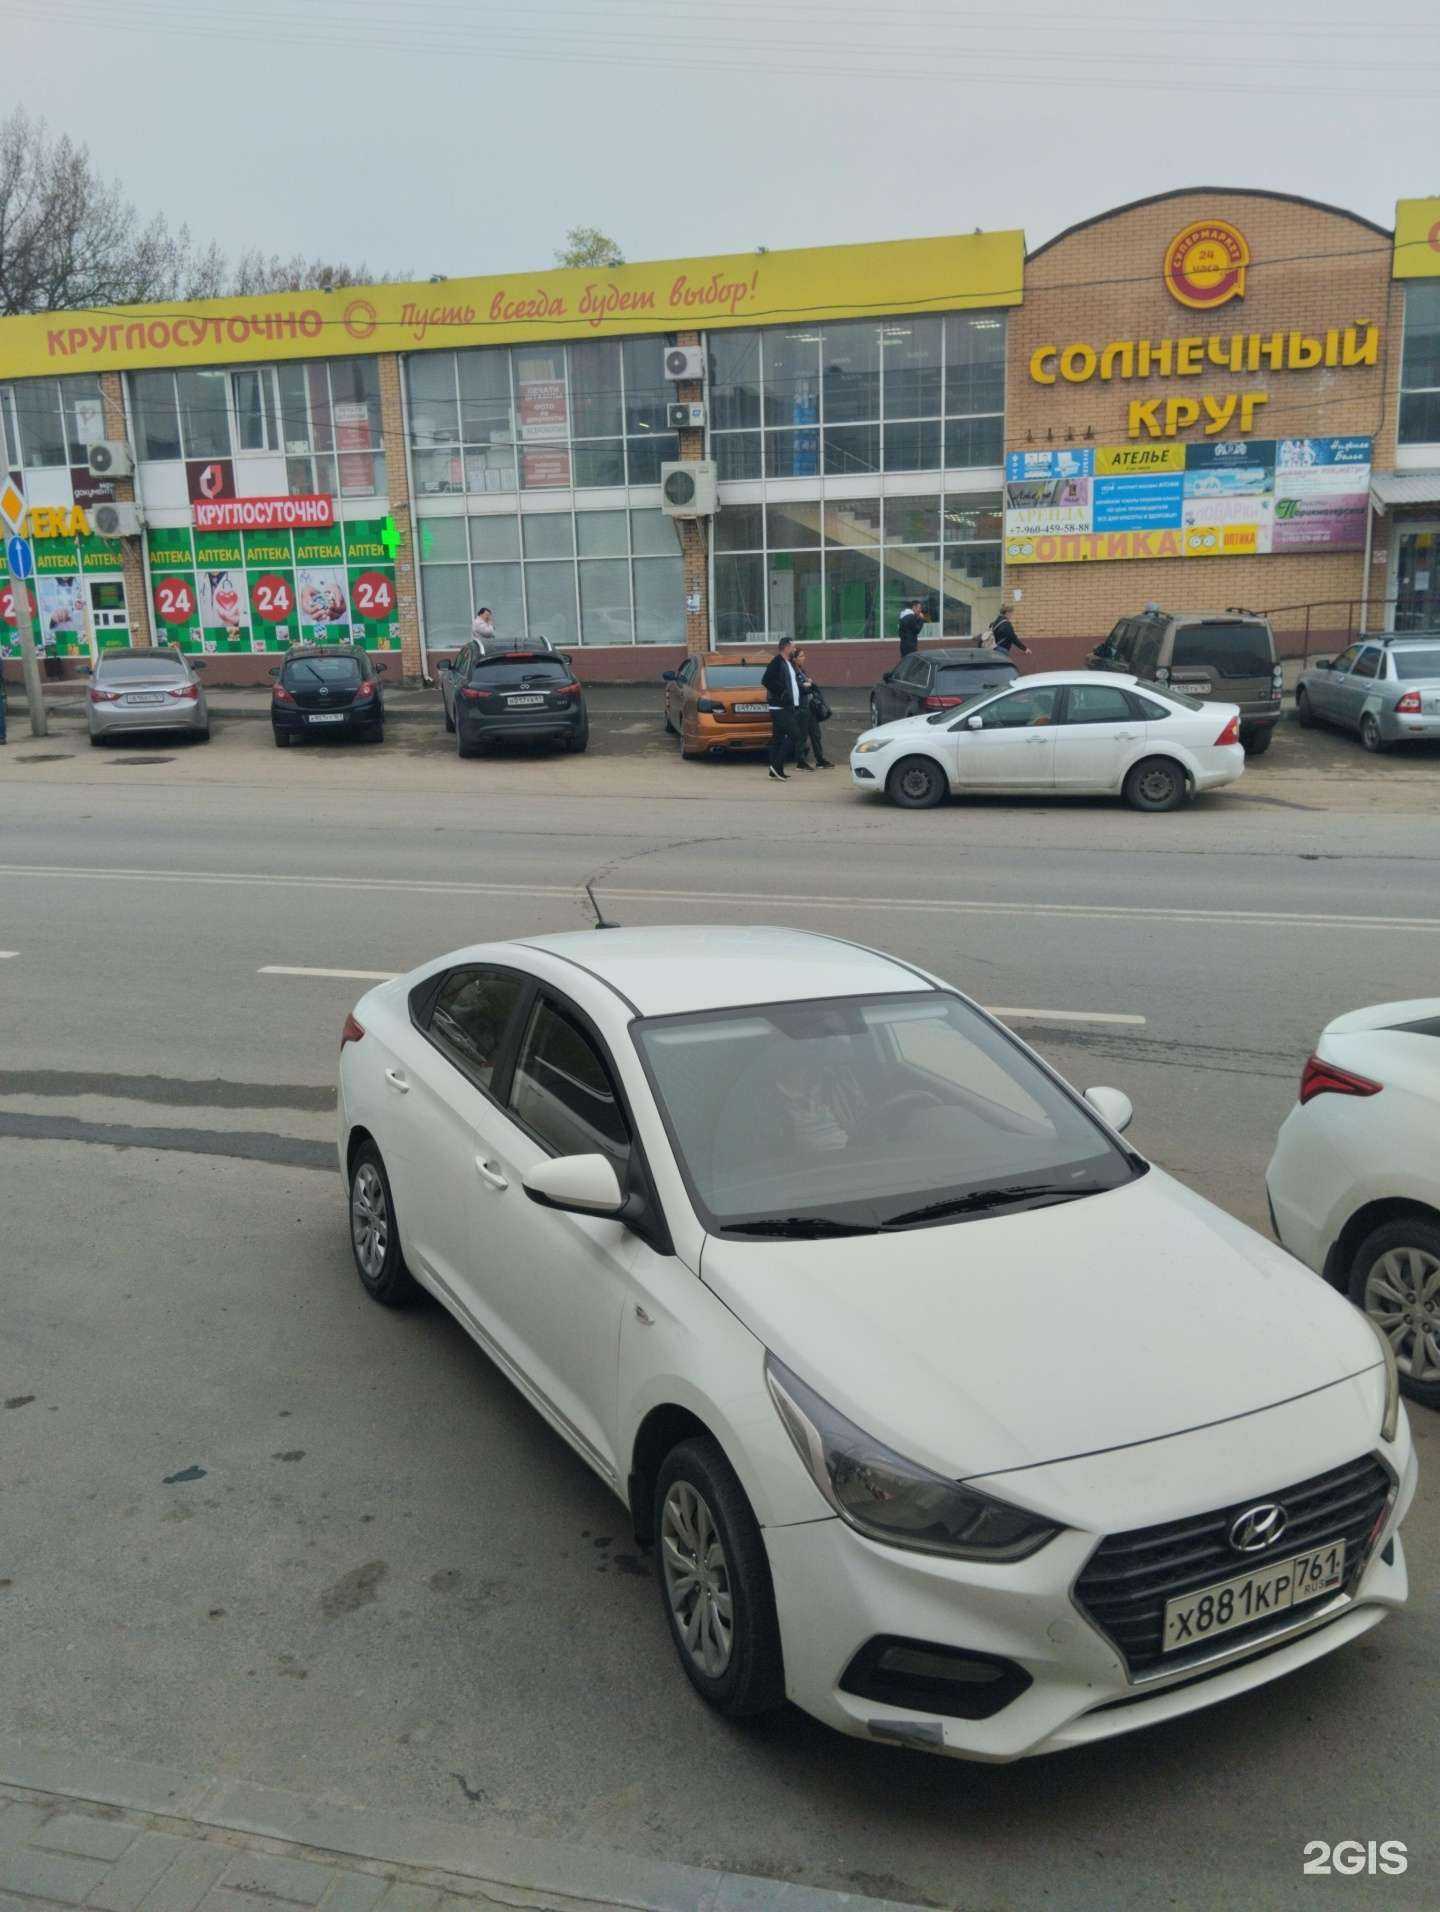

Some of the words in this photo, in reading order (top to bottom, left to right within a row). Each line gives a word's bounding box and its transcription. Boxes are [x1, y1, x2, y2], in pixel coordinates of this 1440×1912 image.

[1173, 229, 1241, 268] СУПЕРМАРКЕТ
[1199, 250, 1215, 260] 24
[400, 302, 475, 341] Пусть
[489, 290, 568, 321] всегда
[579, 283, 656, 327] будет
[669, 270, 760, 314] выбор!
[47, 308, 323, 357] КРУГЛОСУТОЧНО
[1030, 319, 1379, 384] СОЛНЕЧНЫЙ
[1128, 393, 1268, 438] КРУГ
[1112, 450, 1170, 466] АТЕЛЬЕ
[197, 500, 329, 525] КРУГЛОСУТОЧНО
[1035, 532, 1179, 561] ОПТИКА
[1224, 531, 1256, 546] ОПТИКА
[83, 553, 123, 566] АПТЕКА
[150, 550, 192, 563] АПТЕКА
[198, 549, 241, 562] АПТЕКА
[247, 547, 290, 560] АПТЕКА
[297, 545, 341, 558] АПТЕКА
[348, 544, 385, 556] АПТЕК
[38, 555, 77, 568] АПТЕКА
[160, 589, 191, 613] 24
[257, 586, 289, 611] 24
[358, 583, 391, 608] 24
[1174, 1575, 1291, 1642] Х881КР
[1297, 1547, 1338, 1587] 761
[1304, 1580, 1325, 1595] RUS
